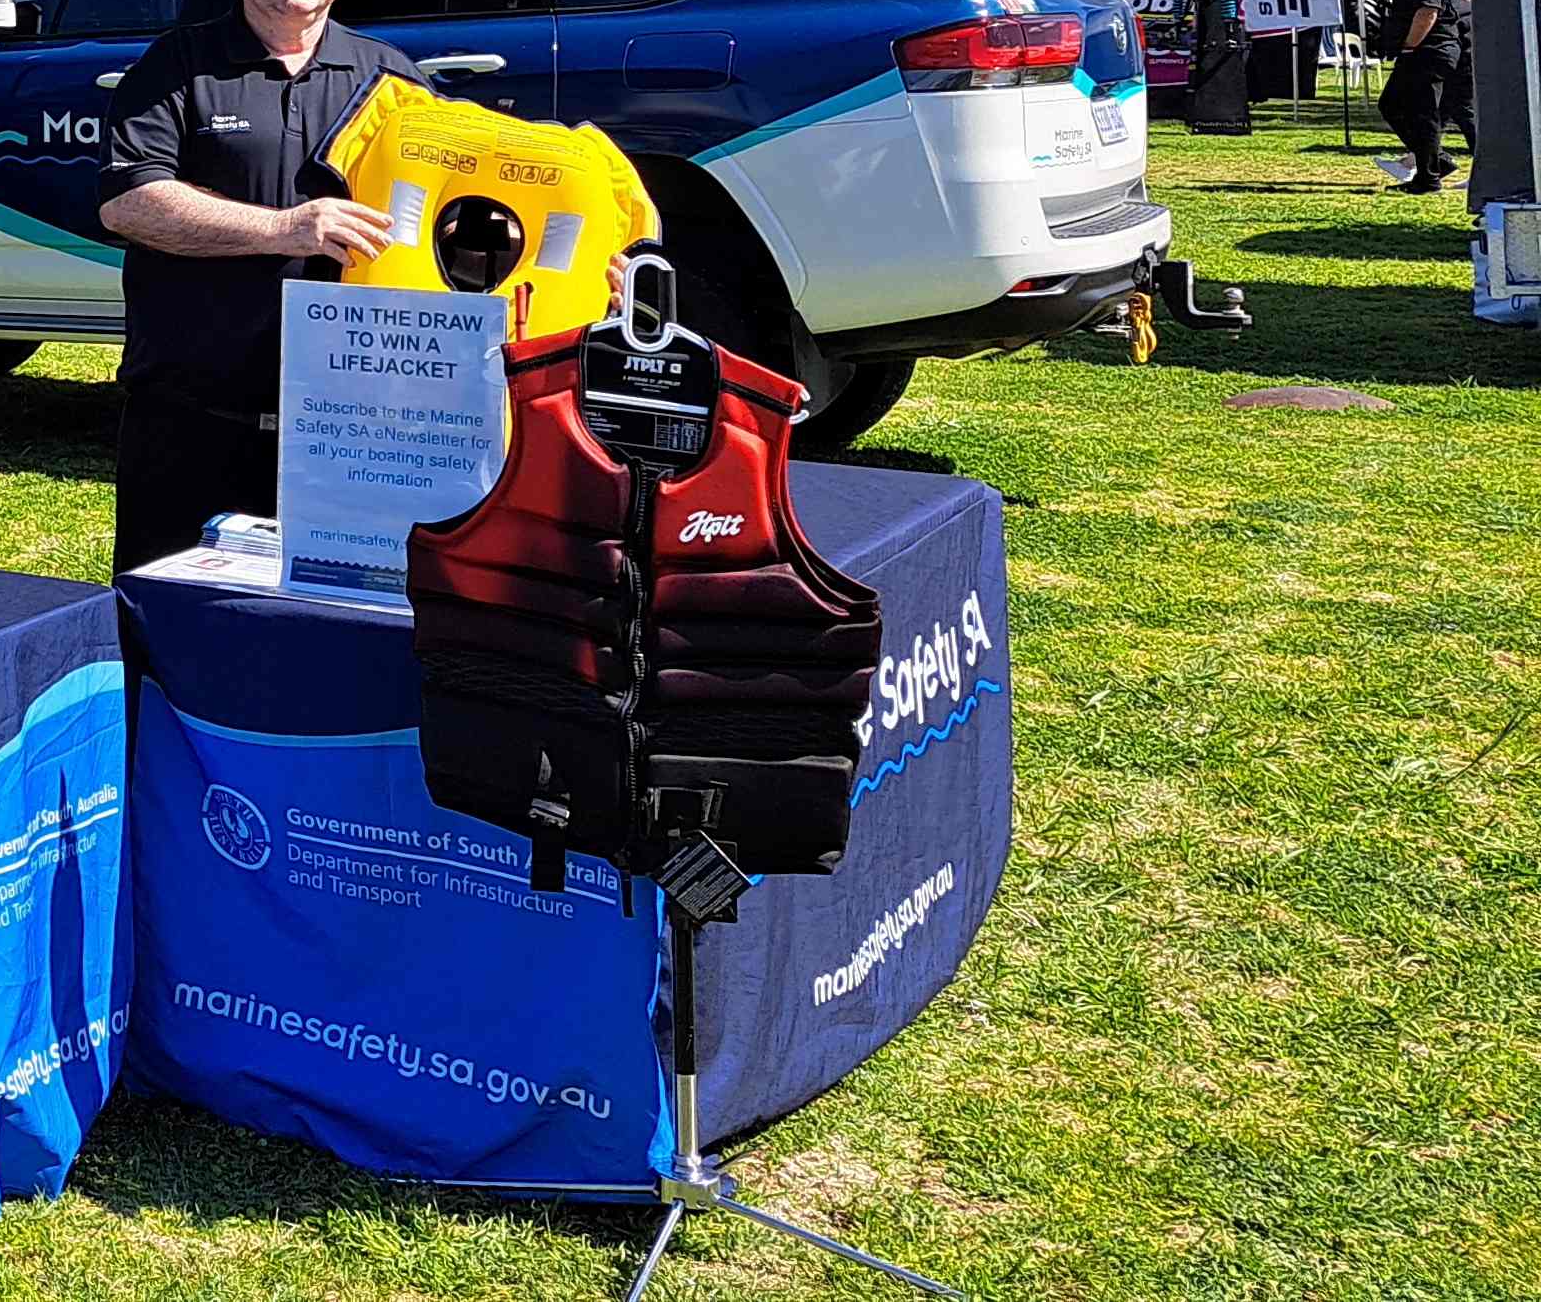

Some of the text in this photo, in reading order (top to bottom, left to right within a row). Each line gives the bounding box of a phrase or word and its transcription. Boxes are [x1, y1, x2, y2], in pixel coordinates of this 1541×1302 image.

[307, 304, 483, 332] GO IN THE DRAW
[347, 330, 441, 354] TO WIN A
[329, 353, 458, 379] LIFEJACKET
[303, 398, 484, 428] Subscribe to the Marine
[295, 419, 492, 450] Safety SA eNewsletter for
[308, 443, 476, 474] all your boating safety
[348, 467, 433, 489] information
[878, 619, 961, 730] Safety
[962, 590, 992, 666] SA
[286, 808, 519, 867] Government of South
[288, 843, 575, 919] Department for Infrastructure
[288, 867, 422, 910] and Transport
[174, 982, 612, 1120] marinesafety.sa.gov.au
